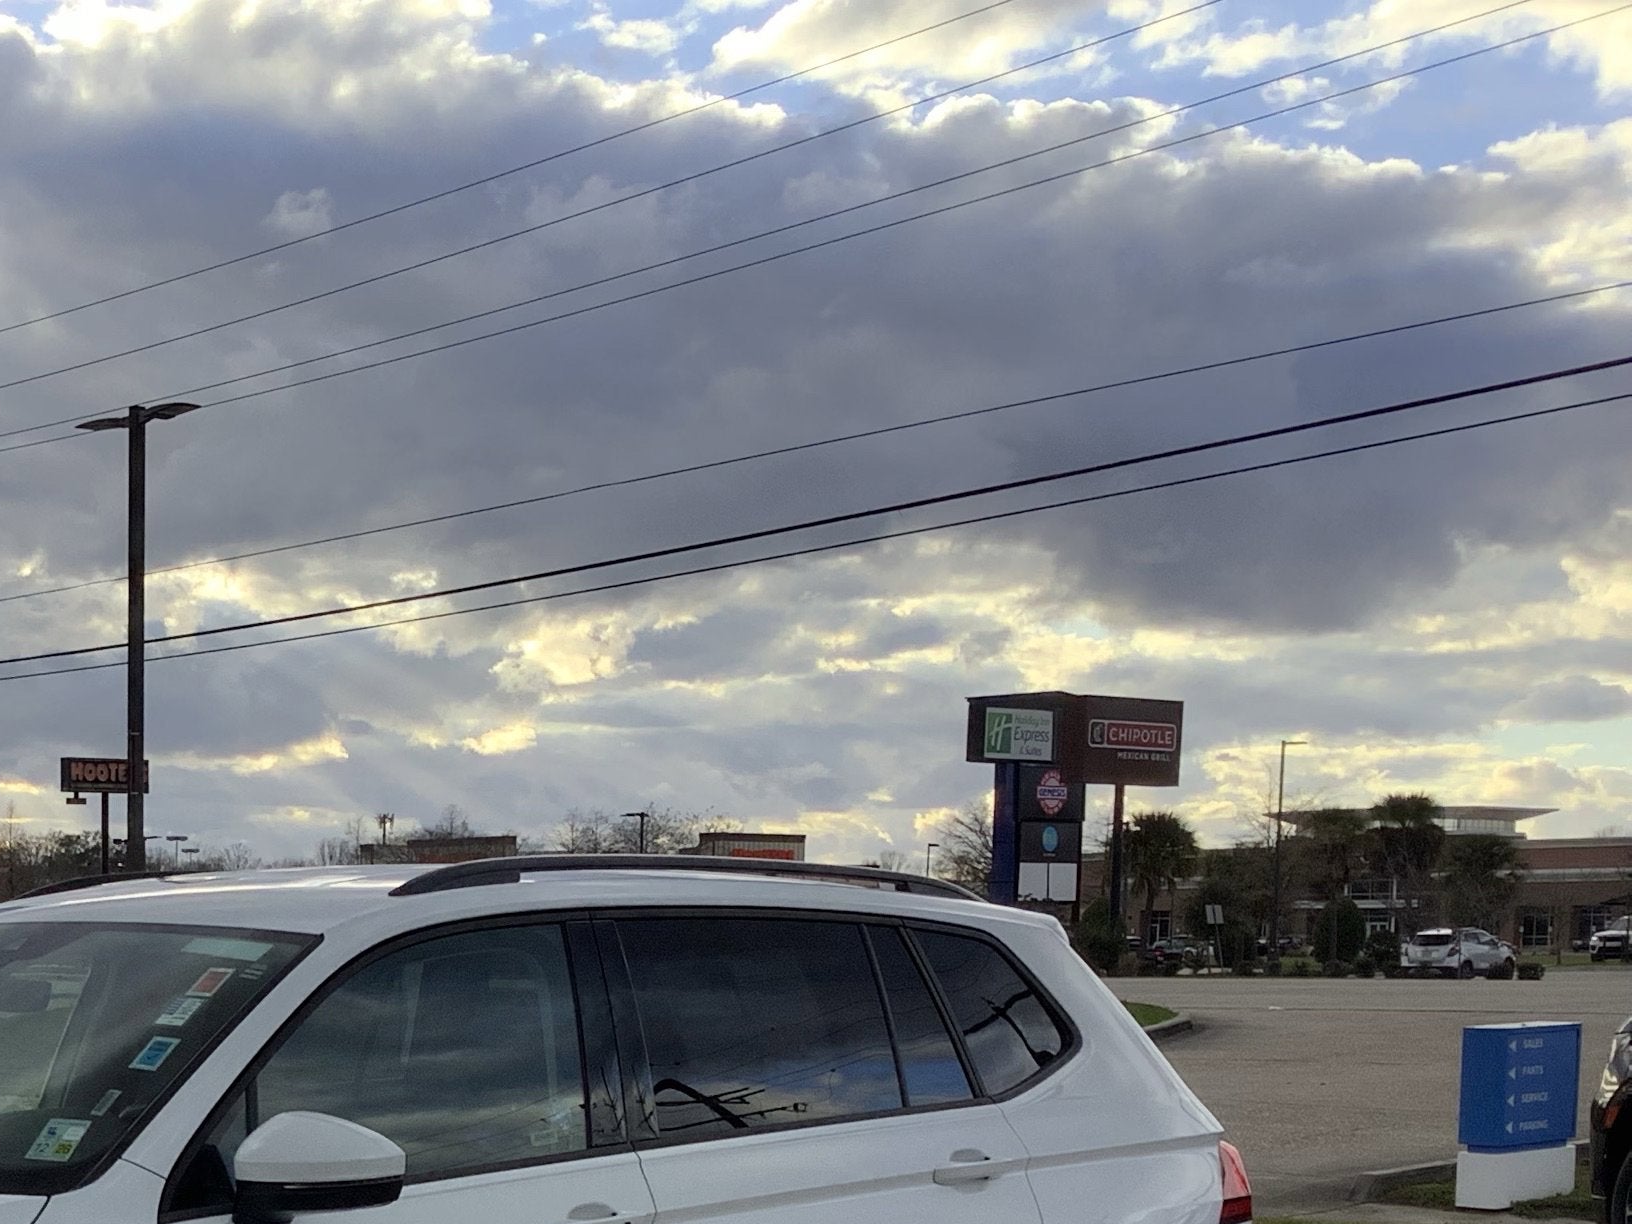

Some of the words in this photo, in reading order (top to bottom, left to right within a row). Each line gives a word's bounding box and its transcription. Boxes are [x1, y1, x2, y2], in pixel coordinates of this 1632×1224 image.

[1014, 727, 1050, 743] Express
[1109, 728, 1173, 744] CHIPOTLE
[1117, 751, 1150, 760] MEXICAN
[1151, 753, 1171, 762] GRILL
[1522, 1065, 1544, 1075] PARTS
[1521, 1092, 1548, 1103] SERVICE
